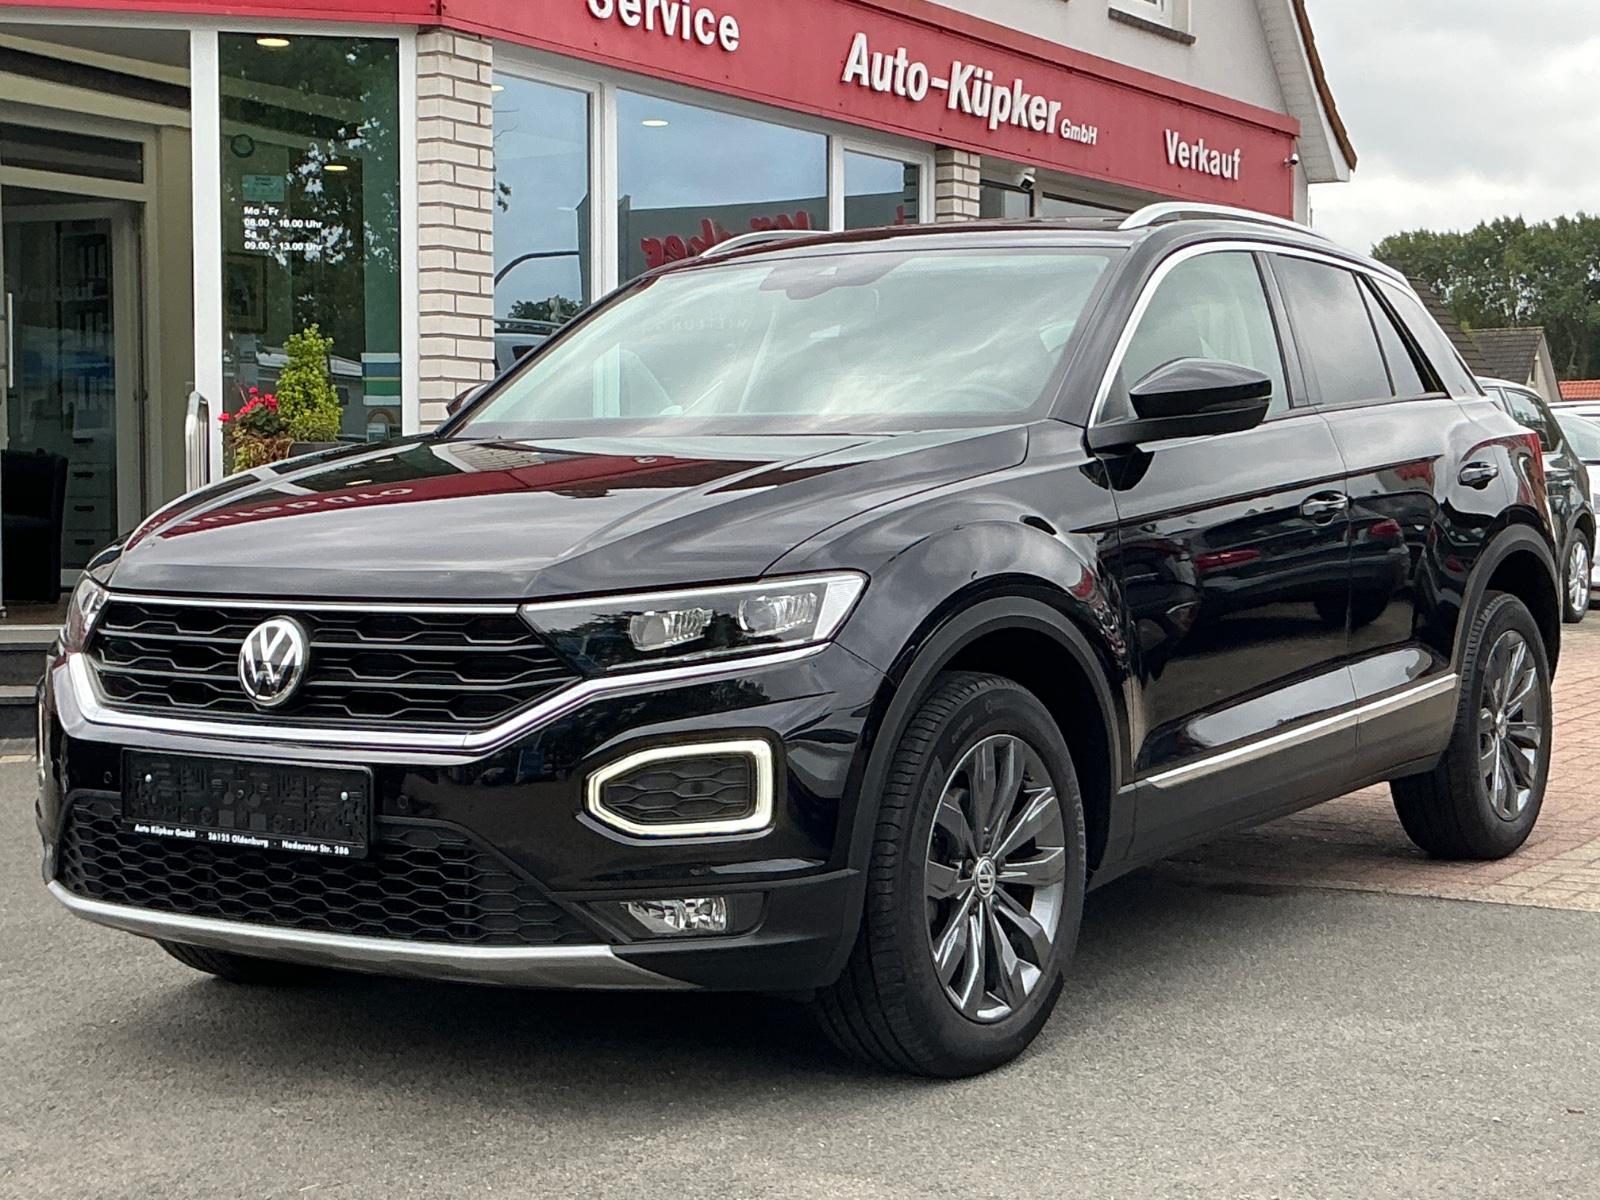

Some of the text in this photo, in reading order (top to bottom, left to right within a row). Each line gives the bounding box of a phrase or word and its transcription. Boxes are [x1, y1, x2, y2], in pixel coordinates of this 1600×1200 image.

[841, 32, 1098, 146] Auto-Küpker GmbH
[1165, 128, 1240, 181] Verkauf
[243, 206, 260, 216] Mo
[268, 206, 280, 216] Fr
[305, 219, 323, 229] Uhr
[244, 229, 257, 239] Sa
[305, 242, 323, 251] Uhr
[134, 823, 150, 833] Auto
[175, 828, 196, 839] GmbH
[231, 834, 269, 849] Oldenburg
[319, 843, 333, 853] Str.
